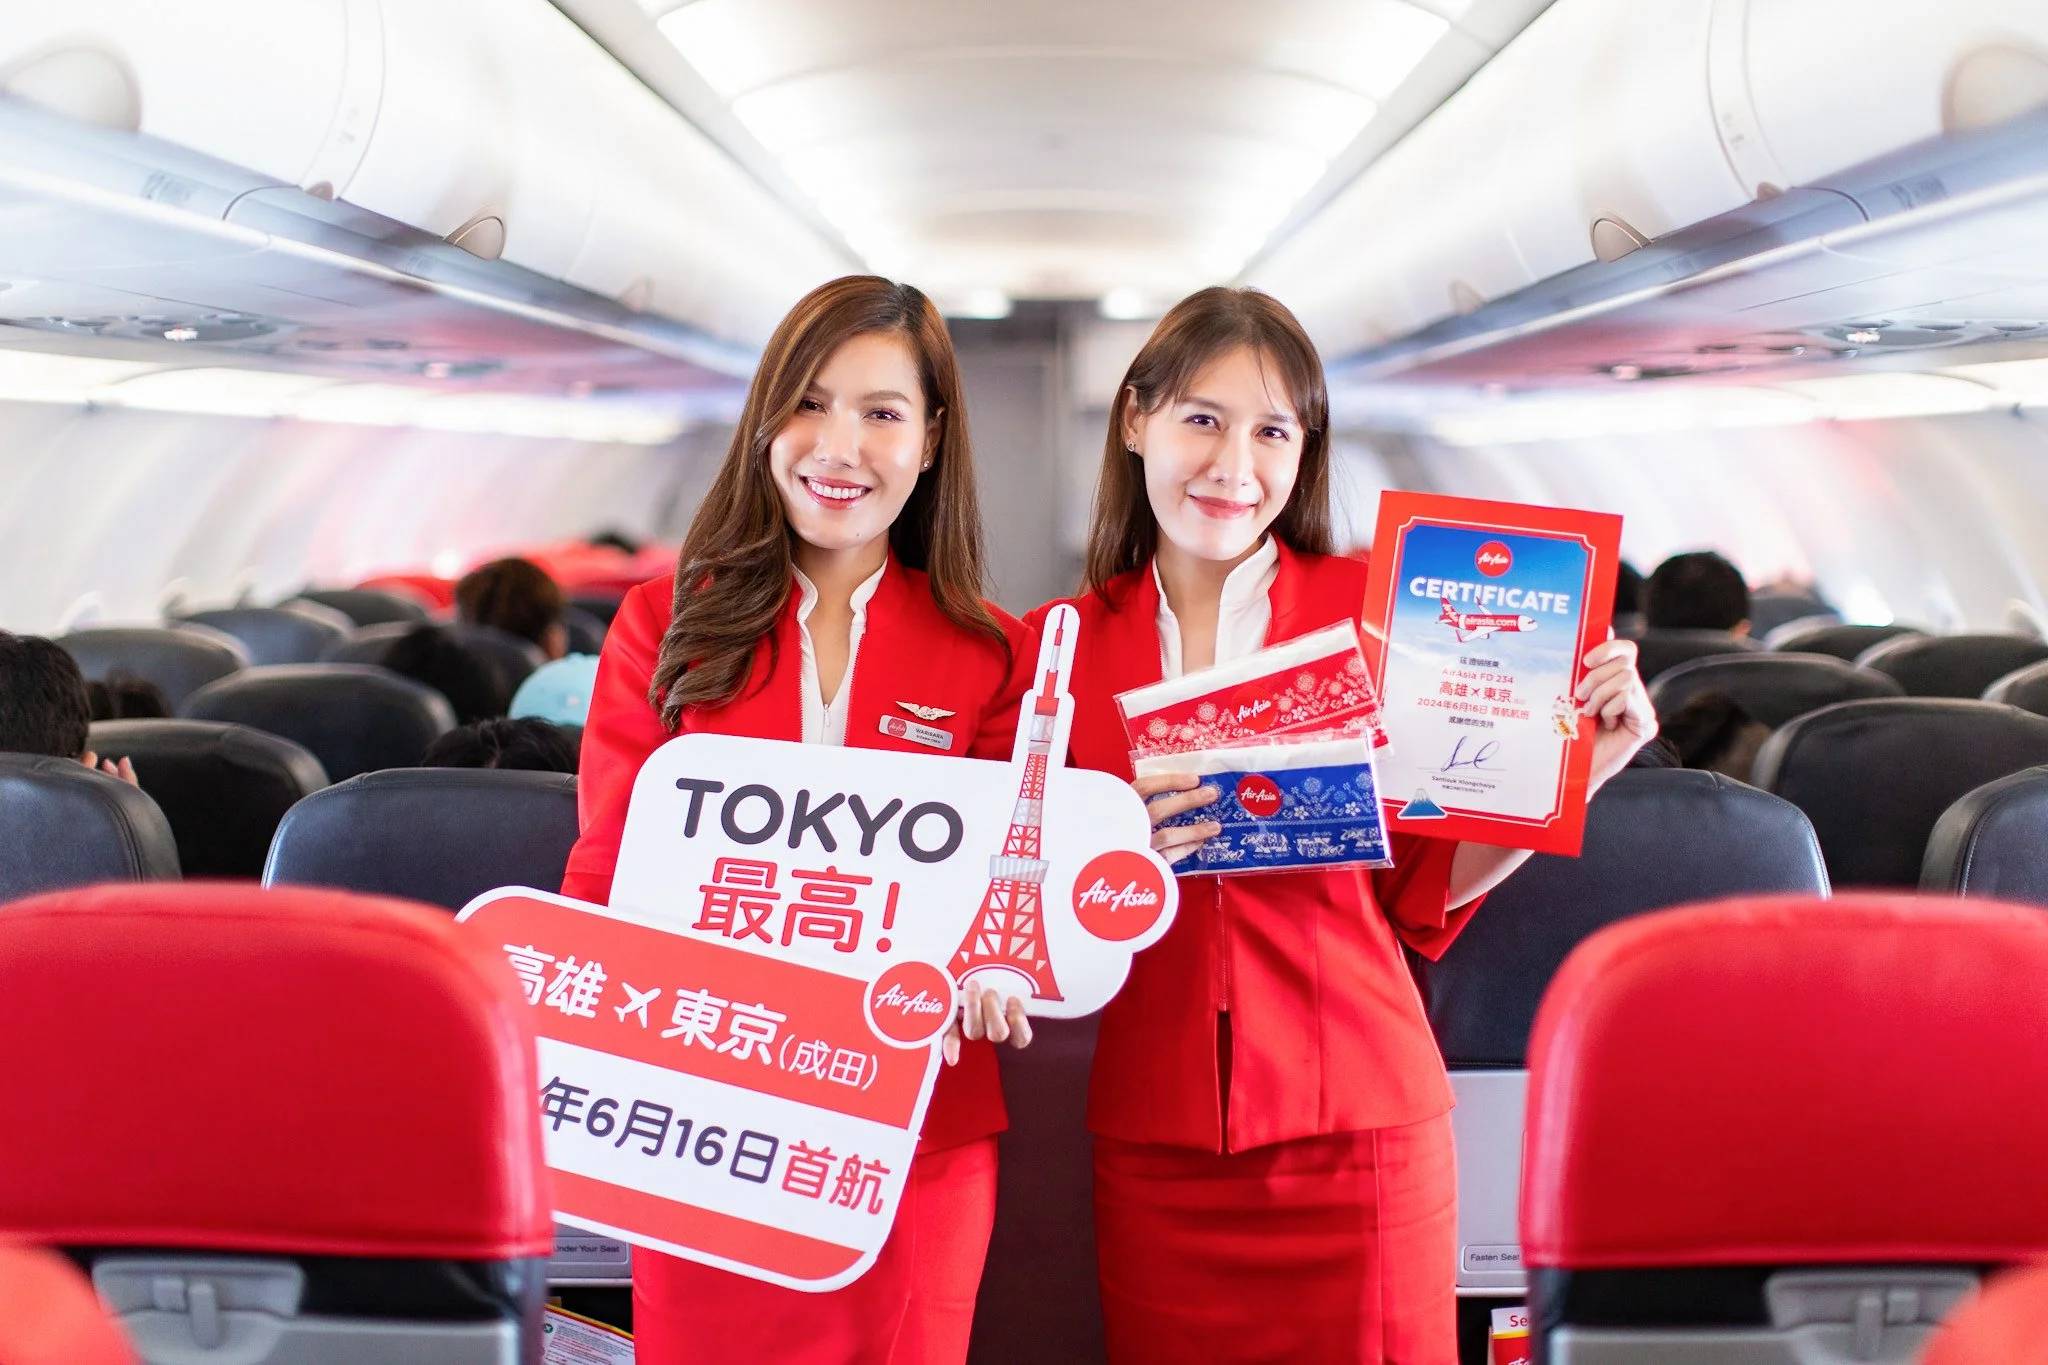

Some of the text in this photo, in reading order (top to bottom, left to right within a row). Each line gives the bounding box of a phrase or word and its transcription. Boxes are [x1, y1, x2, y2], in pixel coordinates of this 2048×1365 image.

[1409, 576, 1570, 615] CERTIFICATE
[1465, 617, 1517, 627] airasia.com
[1441, 667, 1514, 684] AirAsia FD 234
[1417, 697, 1488, 715] 2024年6月16日
[915, 728, 944, 740] WARISARA
[676, 777, 964, 863] TOKYO
[1079, 877, 1158, 912] AirAsia
[692, 857, 900, 953] 最高!
[875, 983, 943, 1015] AirAsia
[580, 1245, 597, 1253] Your
[600, 1245, 619, 1253] Seat
[1501, 1253, 1520, 1261] Seat
